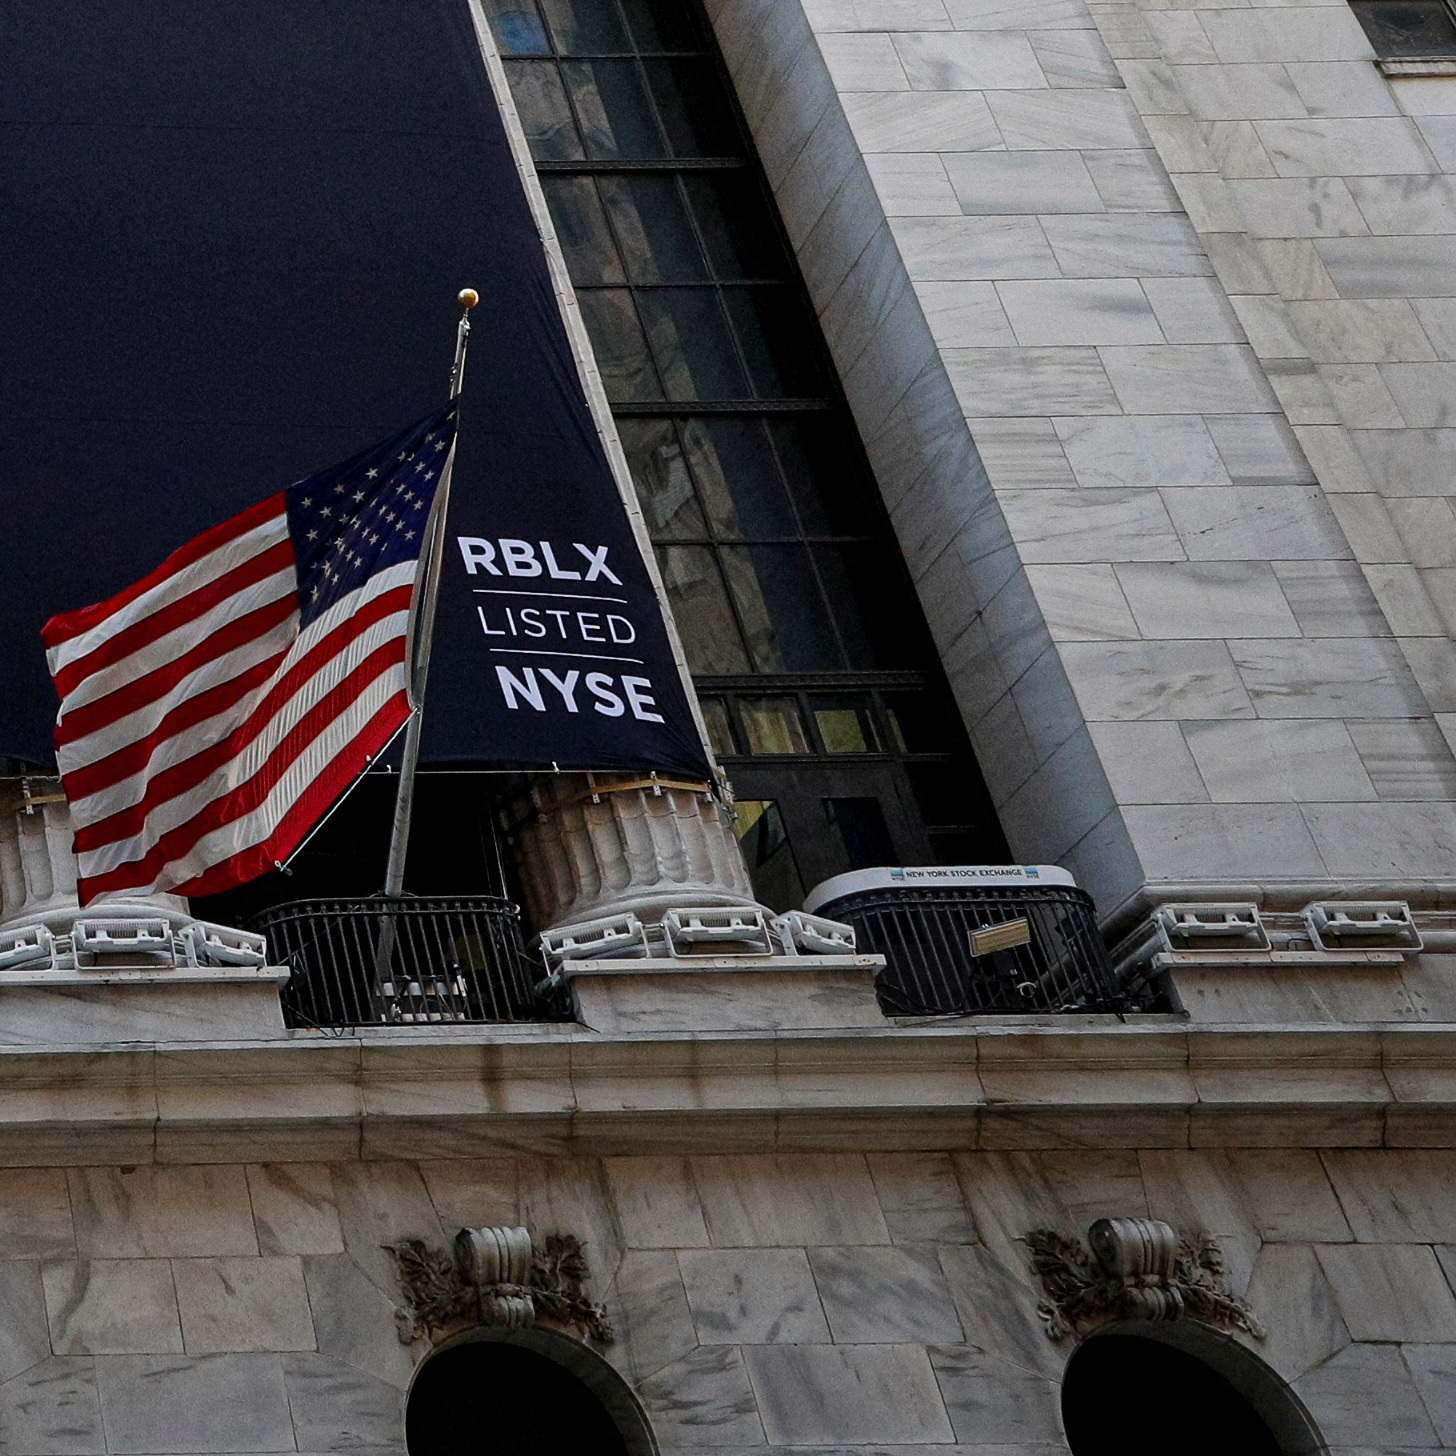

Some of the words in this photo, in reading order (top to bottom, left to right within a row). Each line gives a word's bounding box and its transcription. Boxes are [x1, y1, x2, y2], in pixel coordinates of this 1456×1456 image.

[456, 536, 624, 586] RBLX
[477, 606, 636, 644] LISTED
[494, 665, 666, 724] NYSE
[905, 870, 925, 878] NEW
[926, 870, 949, 878] YORK
[979, 869, 1023, 877] EXCHANGE
